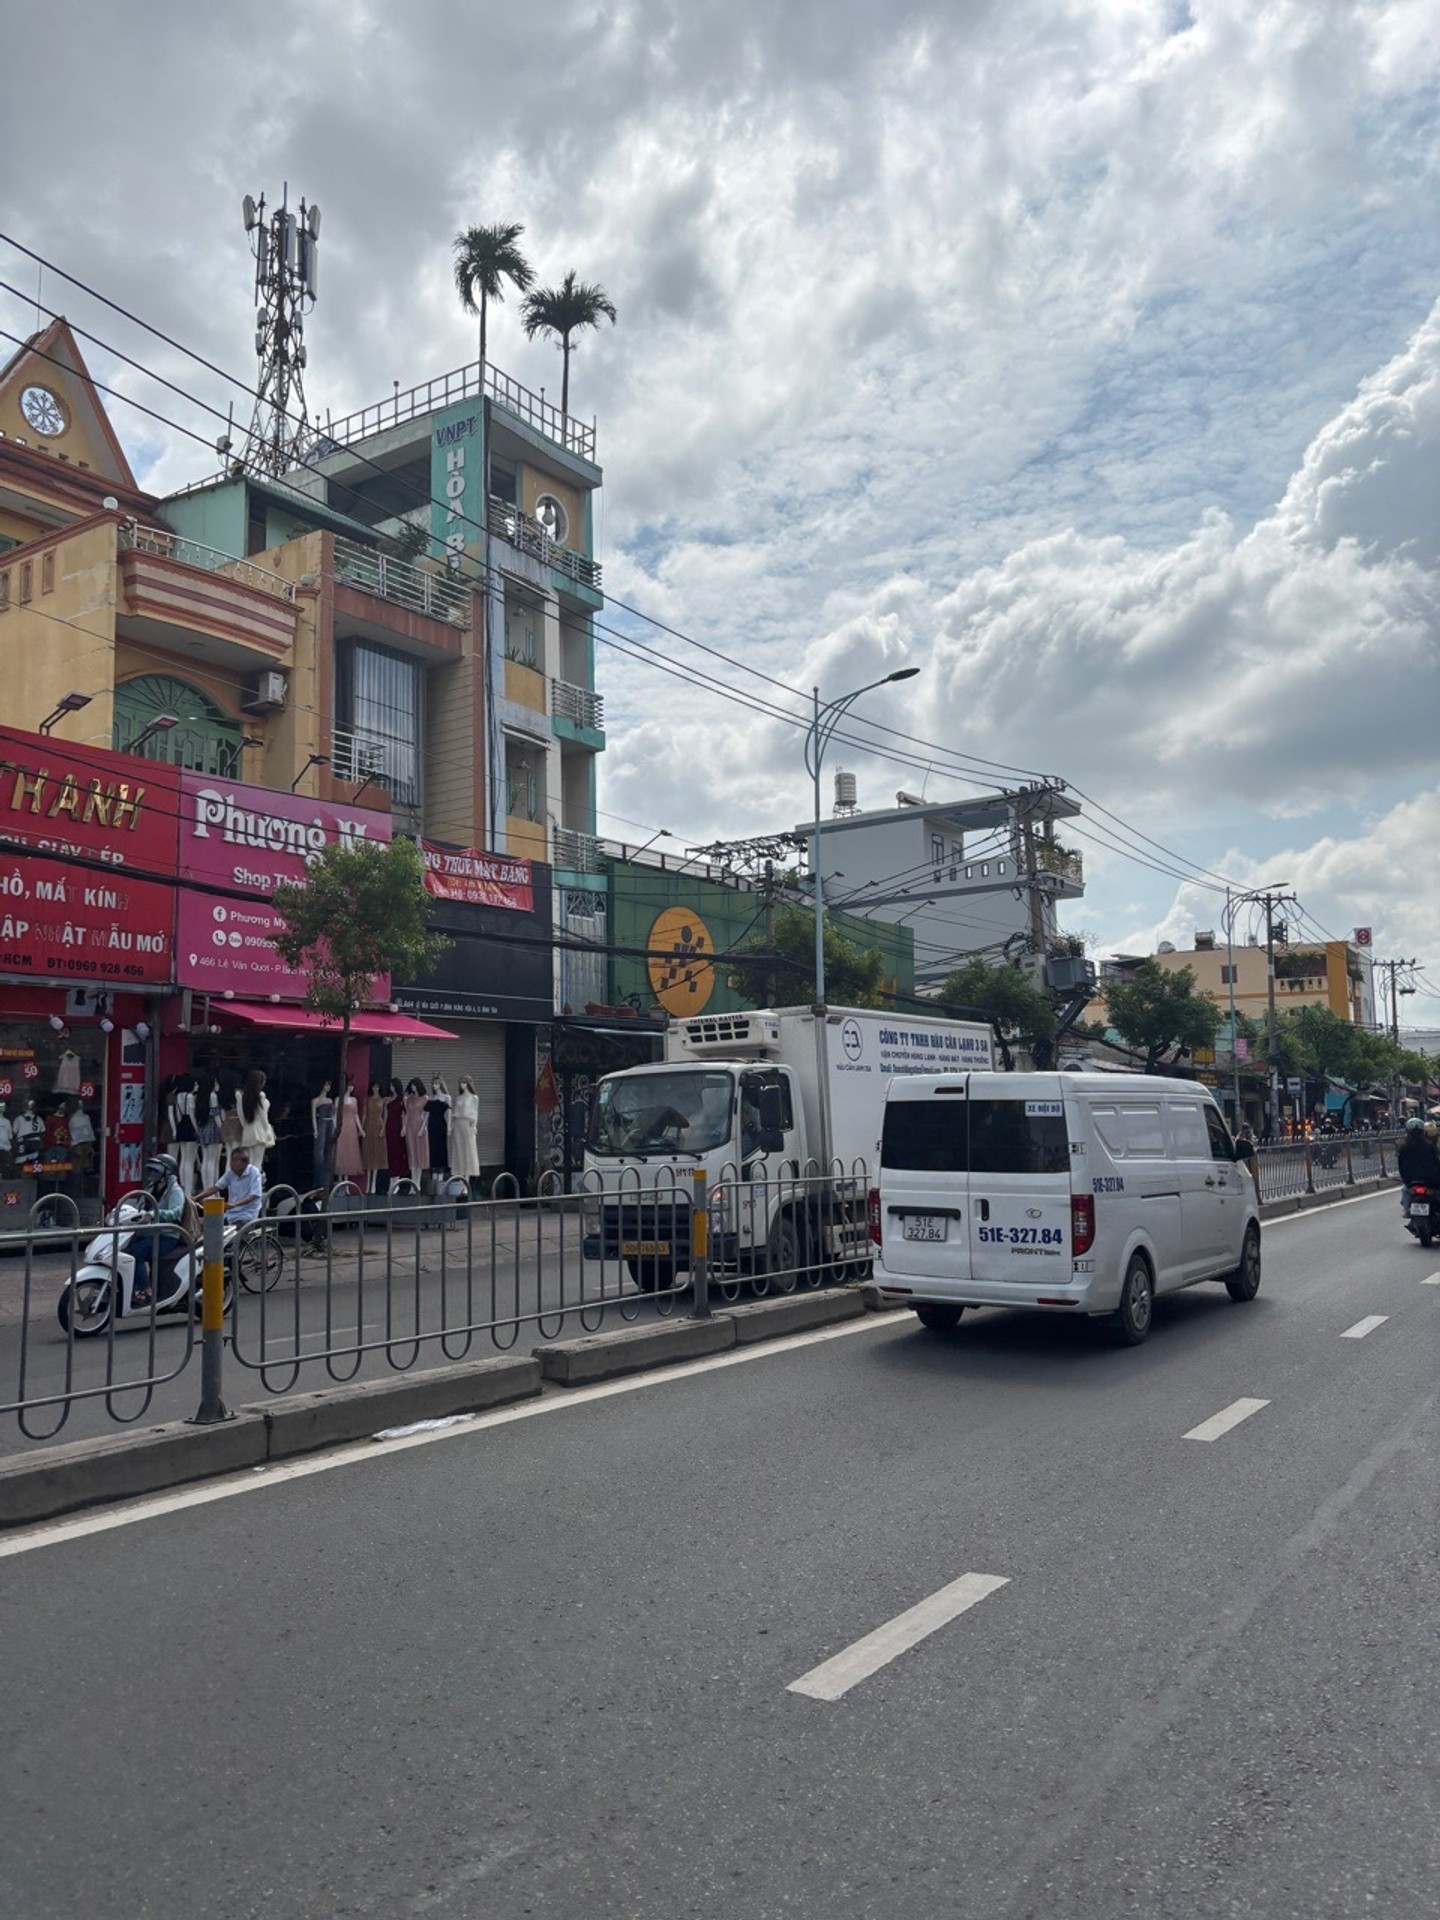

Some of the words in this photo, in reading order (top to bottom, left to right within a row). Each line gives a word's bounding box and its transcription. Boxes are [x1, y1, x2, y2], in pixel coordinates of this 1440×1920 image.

[436, 416, 478, 447] VNPT
[192, 788, 327, 870] Phương
[233, 866, 271, 891] Shop
[230, 911, 270, 928] Phương
[0, 914, 29, 942] ẬP
[100, 962, 121, 974] 928
[123, 964, 144, 976] 456
[879, 1028, 898, 1045] CÔNG
[899, 1031, 909, 1046] TY
[910, 1033, 930, 1048] TNHH
[25, 1066, 38, 1078] 50
[81, 1086, 93, 1097] 50
[1028, 1104, 1036, 1113] XE
[1092, 1177, 1125, 1193] 51E-327.84
[915, 1216, 933, 1227] 51E
[907, 1227, 941, 1239] 327.84
[978, 1226, 1063, 1244] 51E-327.84
